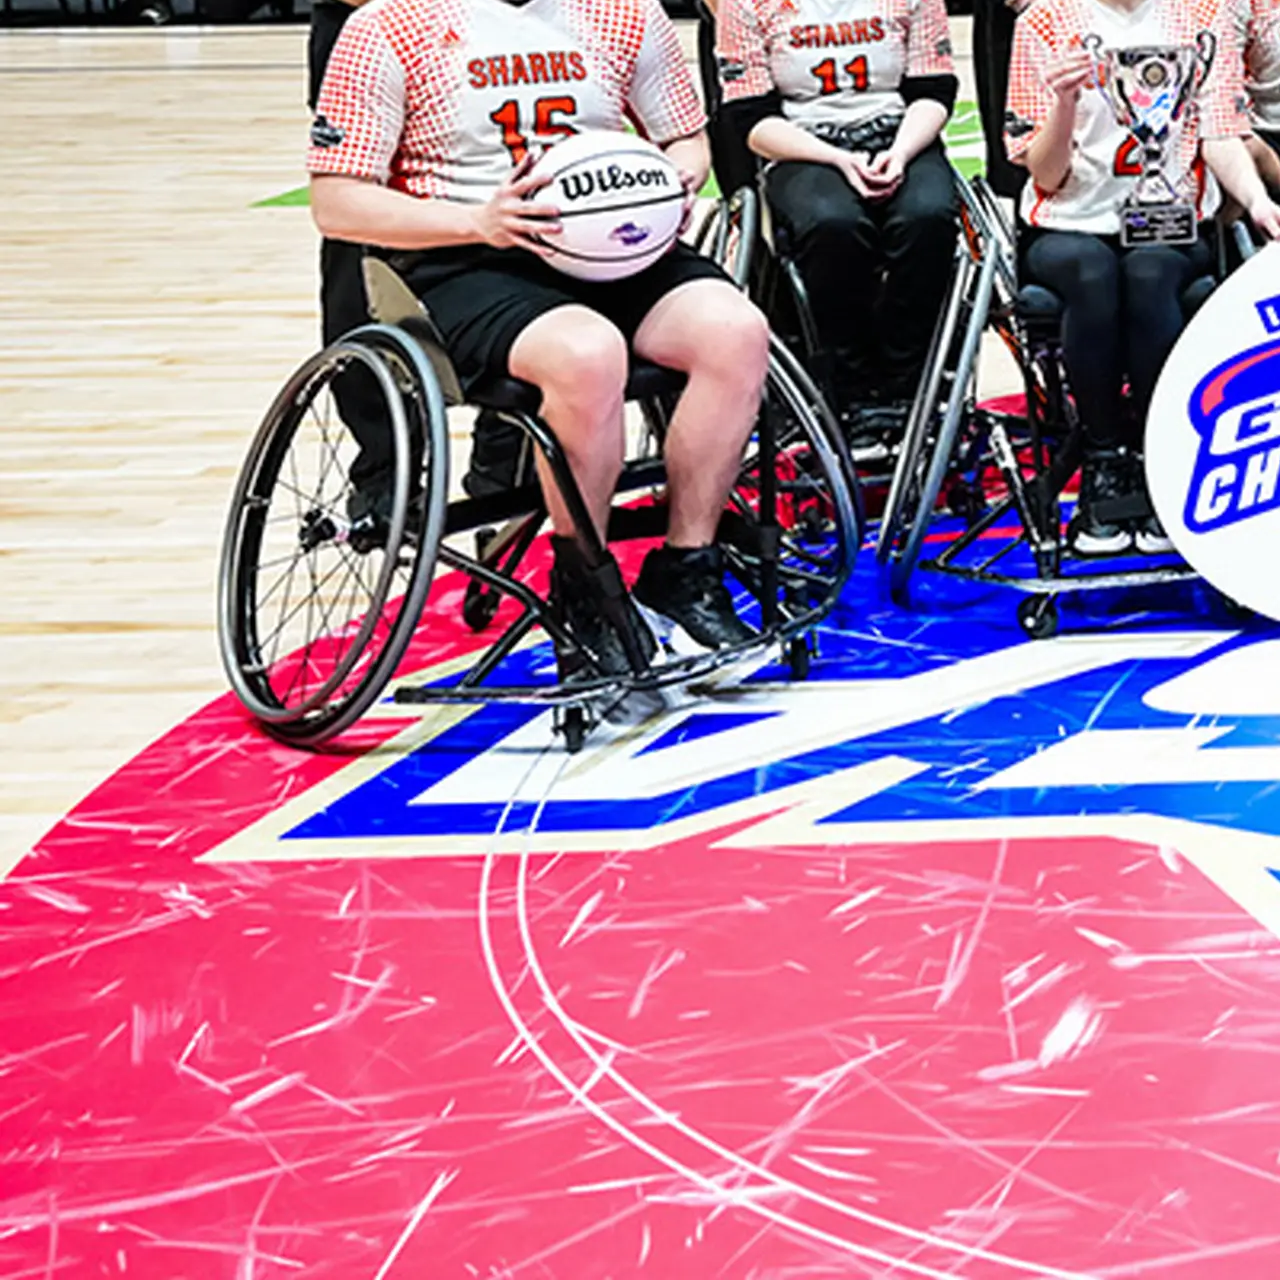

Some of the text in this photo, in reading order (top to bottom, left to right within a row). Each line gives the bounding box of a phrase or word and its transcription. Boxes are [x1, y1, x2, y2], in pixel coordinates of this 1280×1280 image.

[789, 17, 885, 49] SHARKS
[467, 51, 587, 90] SHARKS
[811, 54, 869, 96] 11
[489, 96, 582, 167] 15
[560, 164, 669, 201] Wilson
